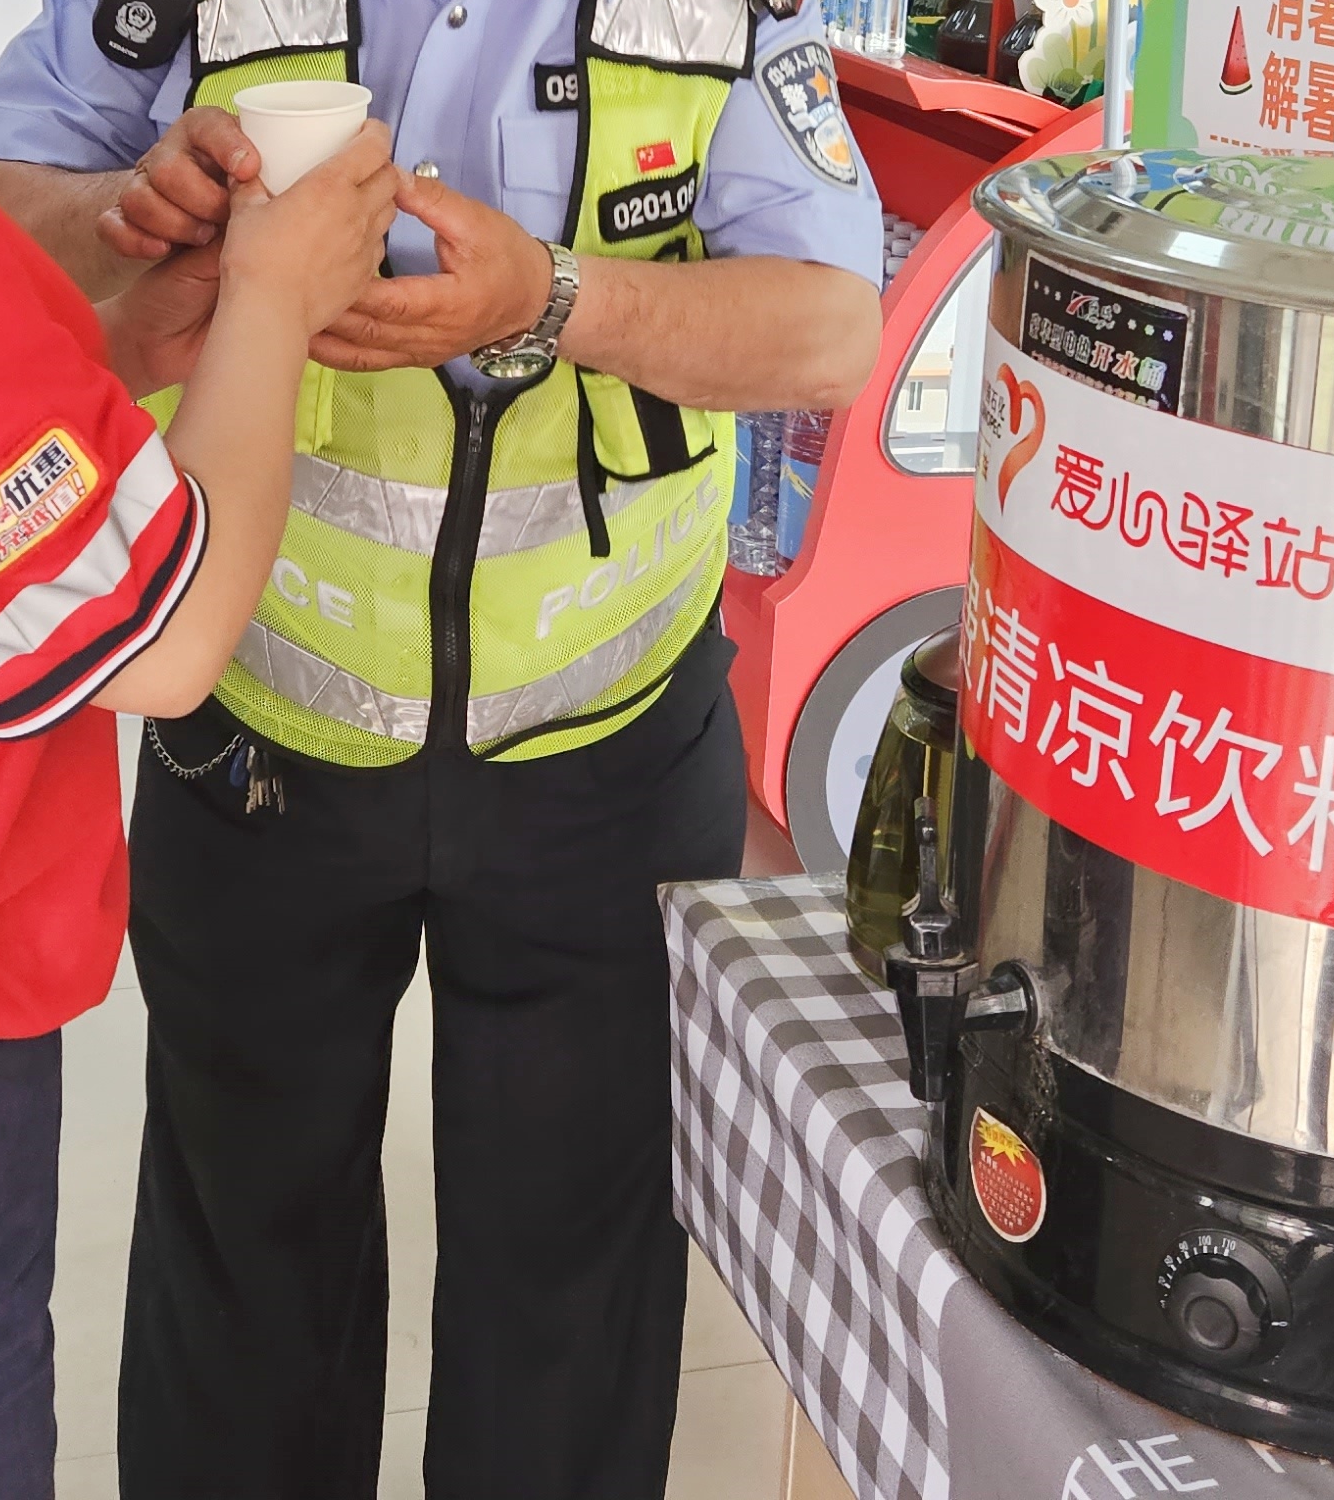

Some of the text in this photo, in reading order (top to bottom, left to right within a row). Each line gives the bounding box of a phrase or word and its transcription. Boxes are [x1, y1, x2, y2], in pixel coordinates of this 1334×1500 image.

[533, 471, 722, 640] POLICE
[1197, 1234, 1212, 1247] 100
[1221, 1236, 1237, 1252] 110
